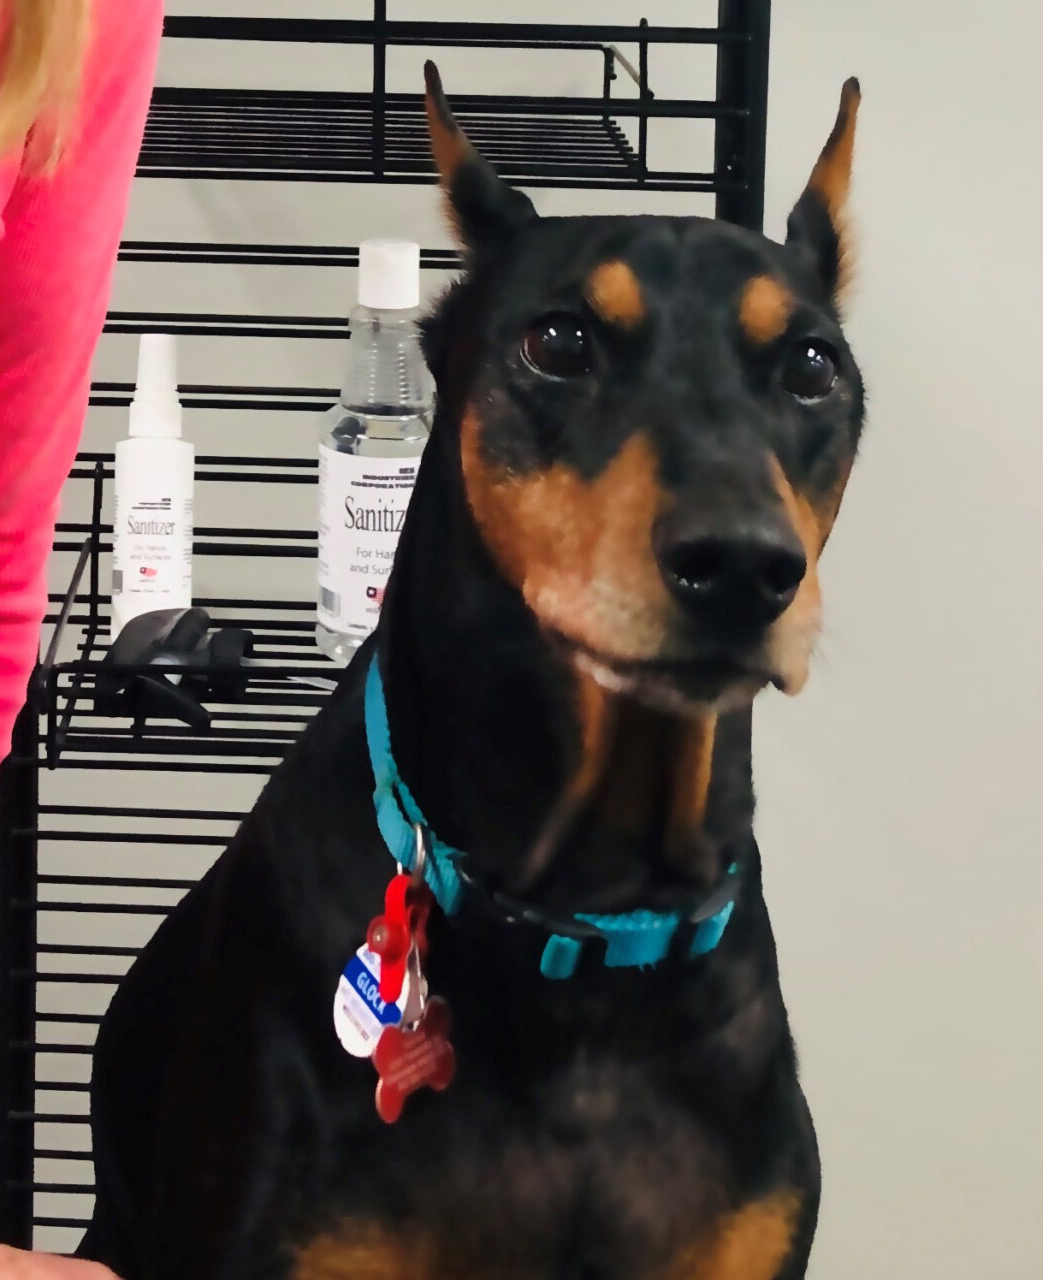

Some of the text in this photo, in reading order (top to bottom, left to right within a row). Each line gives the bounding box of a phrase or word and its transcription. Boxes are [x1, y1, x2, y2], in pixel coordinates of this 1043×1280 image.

[345, 496, 406, 532] Sanitiz
[127, 515, 176, 536] Sanitizer
[356, 547, 396, 560] For Han
[350, 564, 369, 574] and
